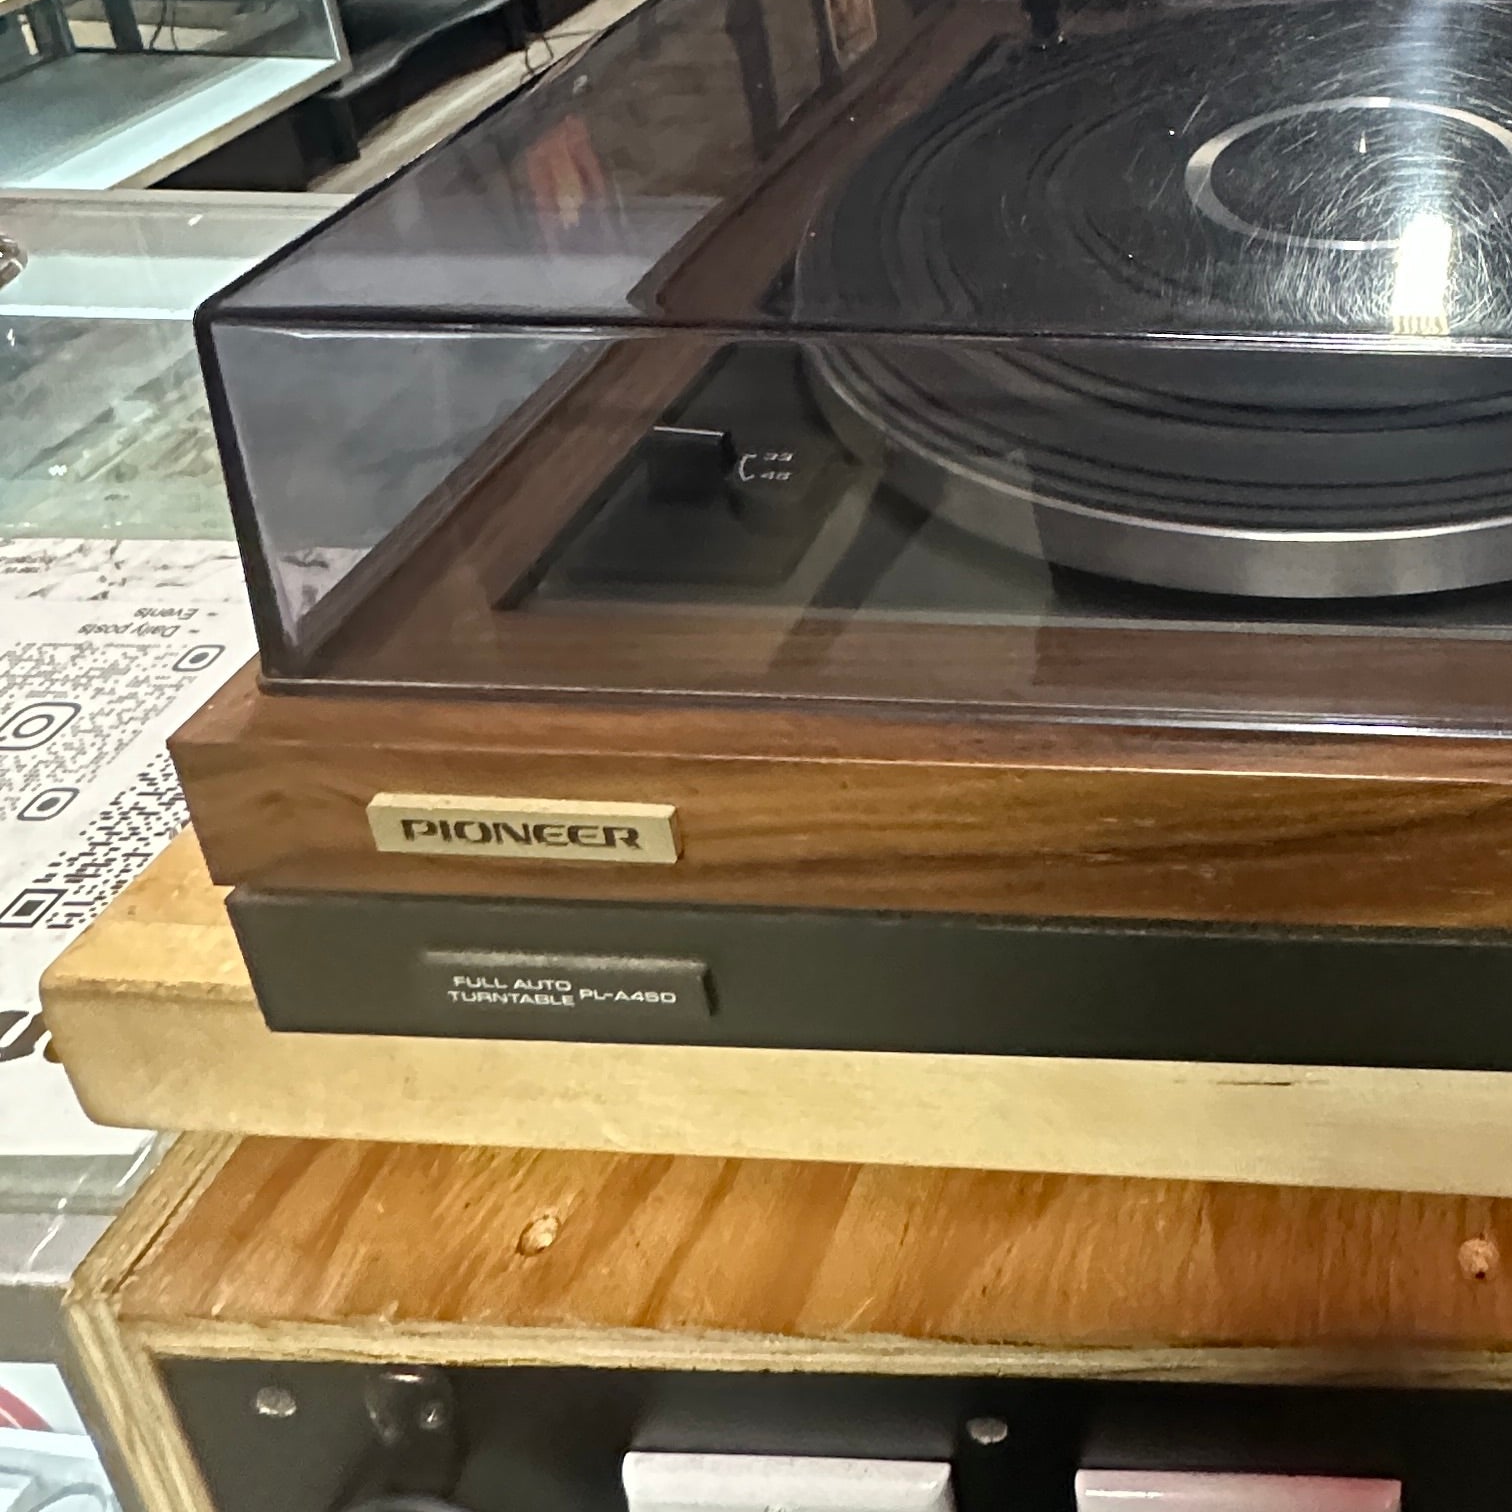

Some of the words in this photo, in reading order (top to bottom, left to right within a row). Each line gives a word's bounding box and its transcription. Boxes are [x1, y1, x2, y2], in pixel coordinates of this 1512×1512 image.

[134, 607, 199, 620] Events
[78, 622, 133, 636] posts
[131, 622, 181, 638] Daily
[400, 818, 643, 850] PIONEER
[452, 975, 508, 990] FULL
[513, 977, 573, 992] AUTO
[447, 990, 576, 1007] TURNTABLE
